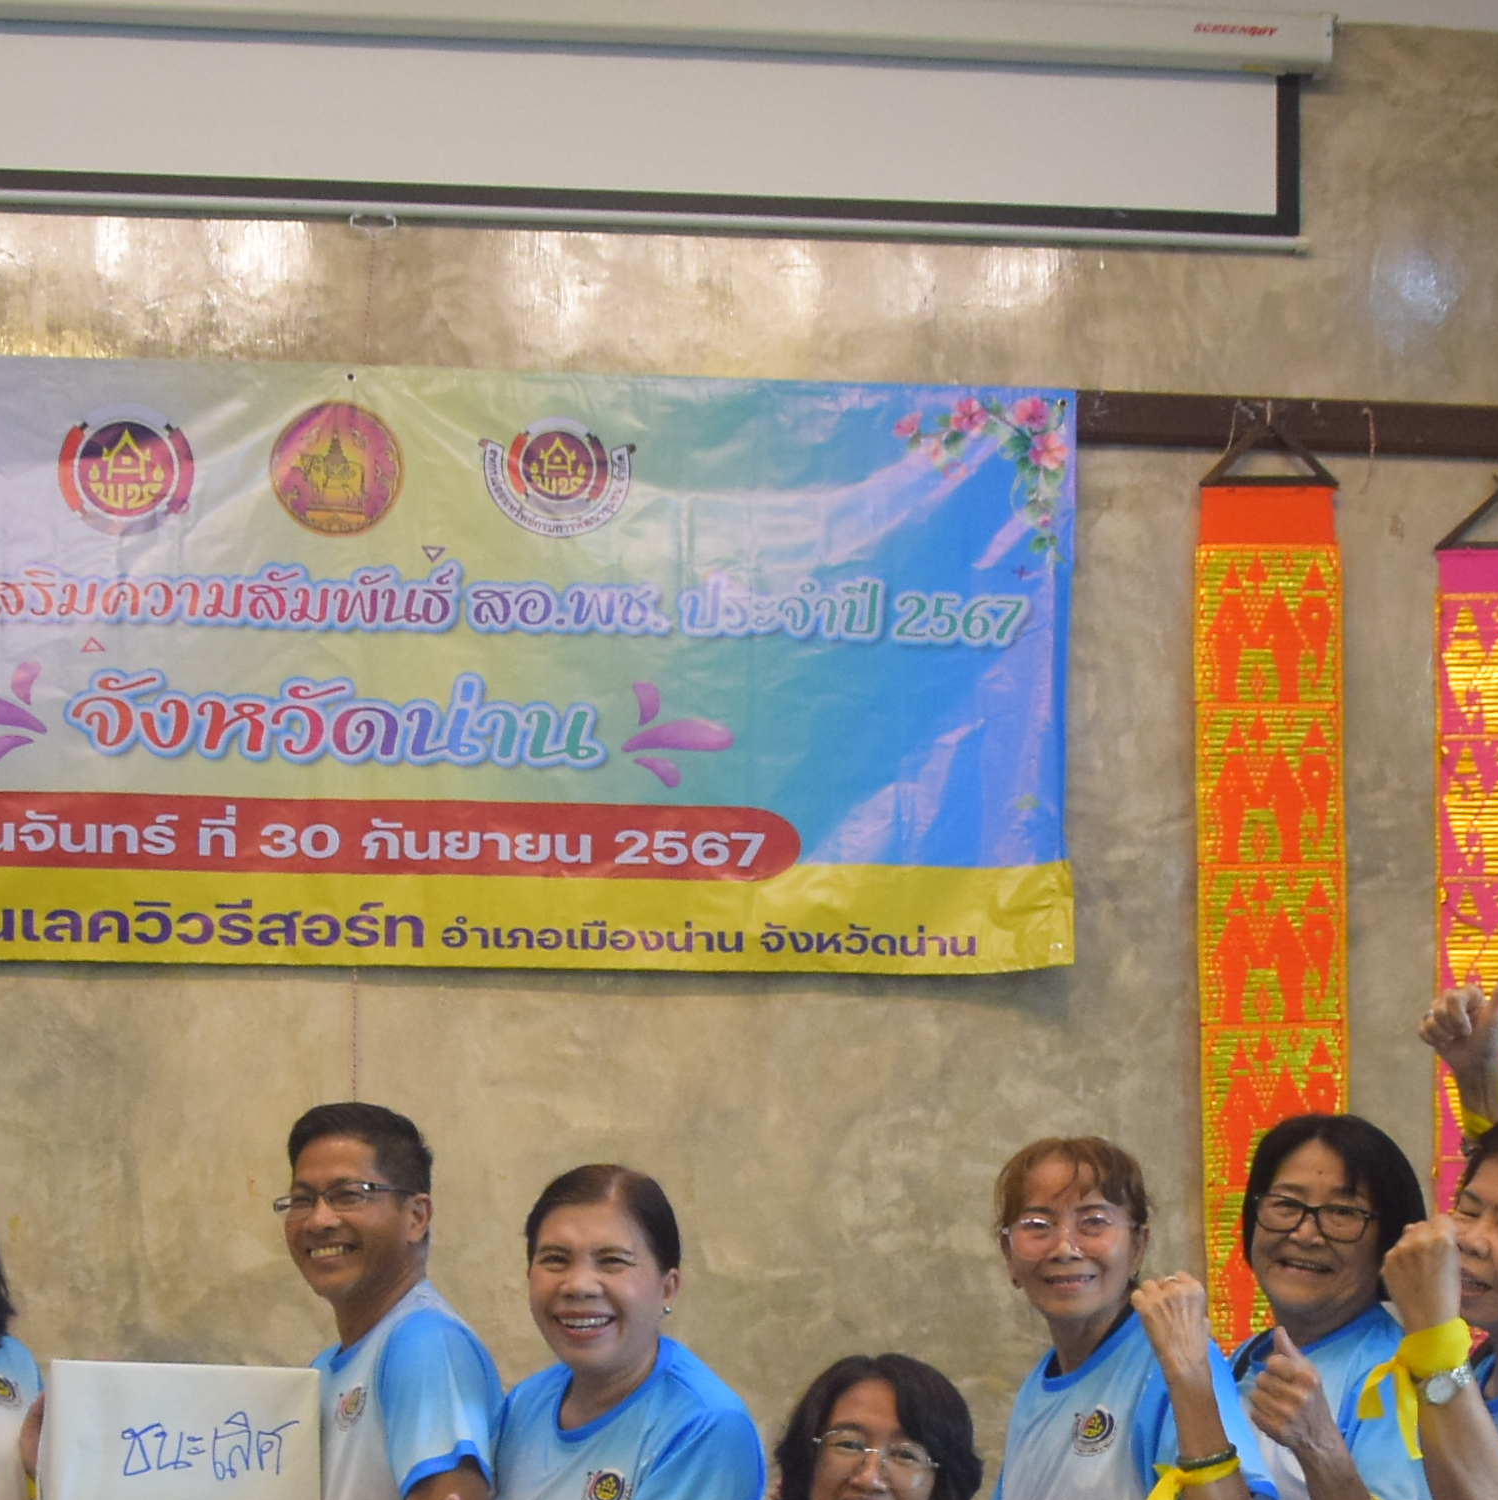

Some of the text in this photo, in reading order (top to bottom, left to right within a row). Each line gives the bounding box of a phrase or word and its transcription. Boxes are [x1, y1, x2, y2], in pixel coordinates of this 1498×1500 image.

[685, 577, 880, 635] ประจำปี
[895, 594, 1024, 640] 2567
[70, 675, 600, 758] จังหวัดน่าน
[198, 804, 237, 858] ที่
[259, 823, 341, 861] 30
[361, 817, 593, 864] กันยายน
[613, 829, 766, 868] 2567
[440, 915, 745, 955] อำเภอเมืองน่าน
[758, 920, 979, 958] จังหวัดน่าน
[121, 1411, 300, 1481] ชนะเลิศ
